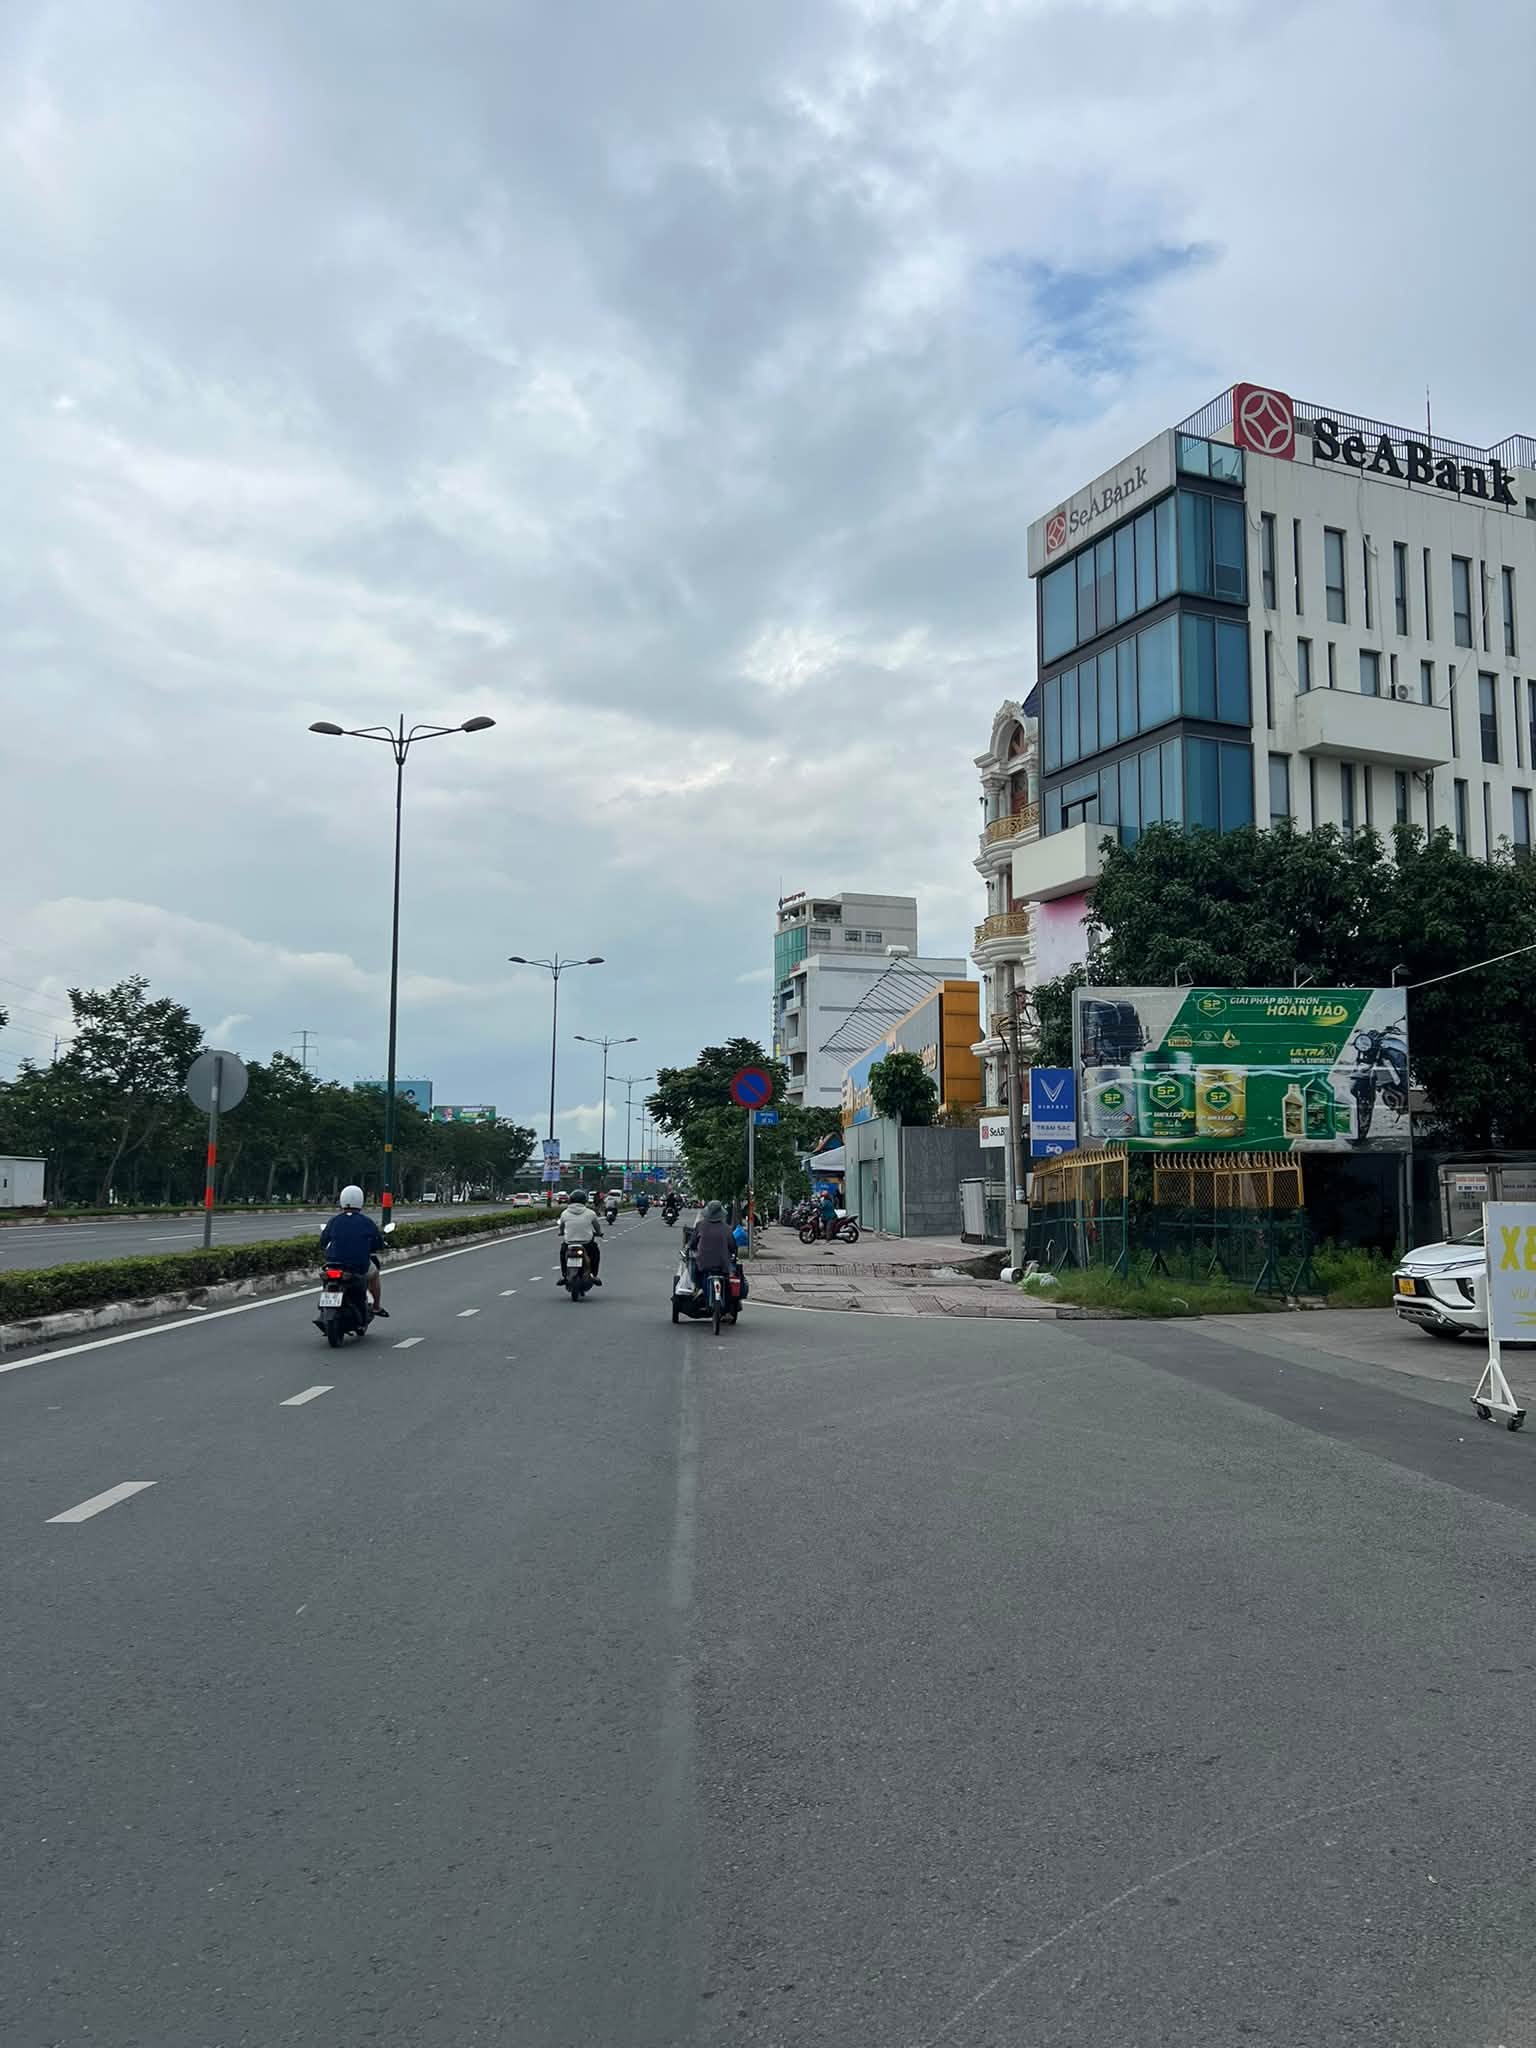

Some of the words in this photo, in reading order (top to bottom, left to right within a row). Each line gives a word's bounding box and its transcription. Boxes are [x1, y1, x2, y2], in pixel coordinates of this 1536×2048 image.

[1313, 416, 1518, 506] SeABank
[1069, 465, 1148, 535] SeABank
[1203, 1000, 1220, 1008] SP
[1250, 995, 1276, 1005] PHÁP
[1266, 1002, 1310, 1016] HOÀN
[1312, 1001, 1345, 1016] HẢO
[1158, 1086, 1175, 1094] SP
[1210, 1091, 1227, 1100] SP
